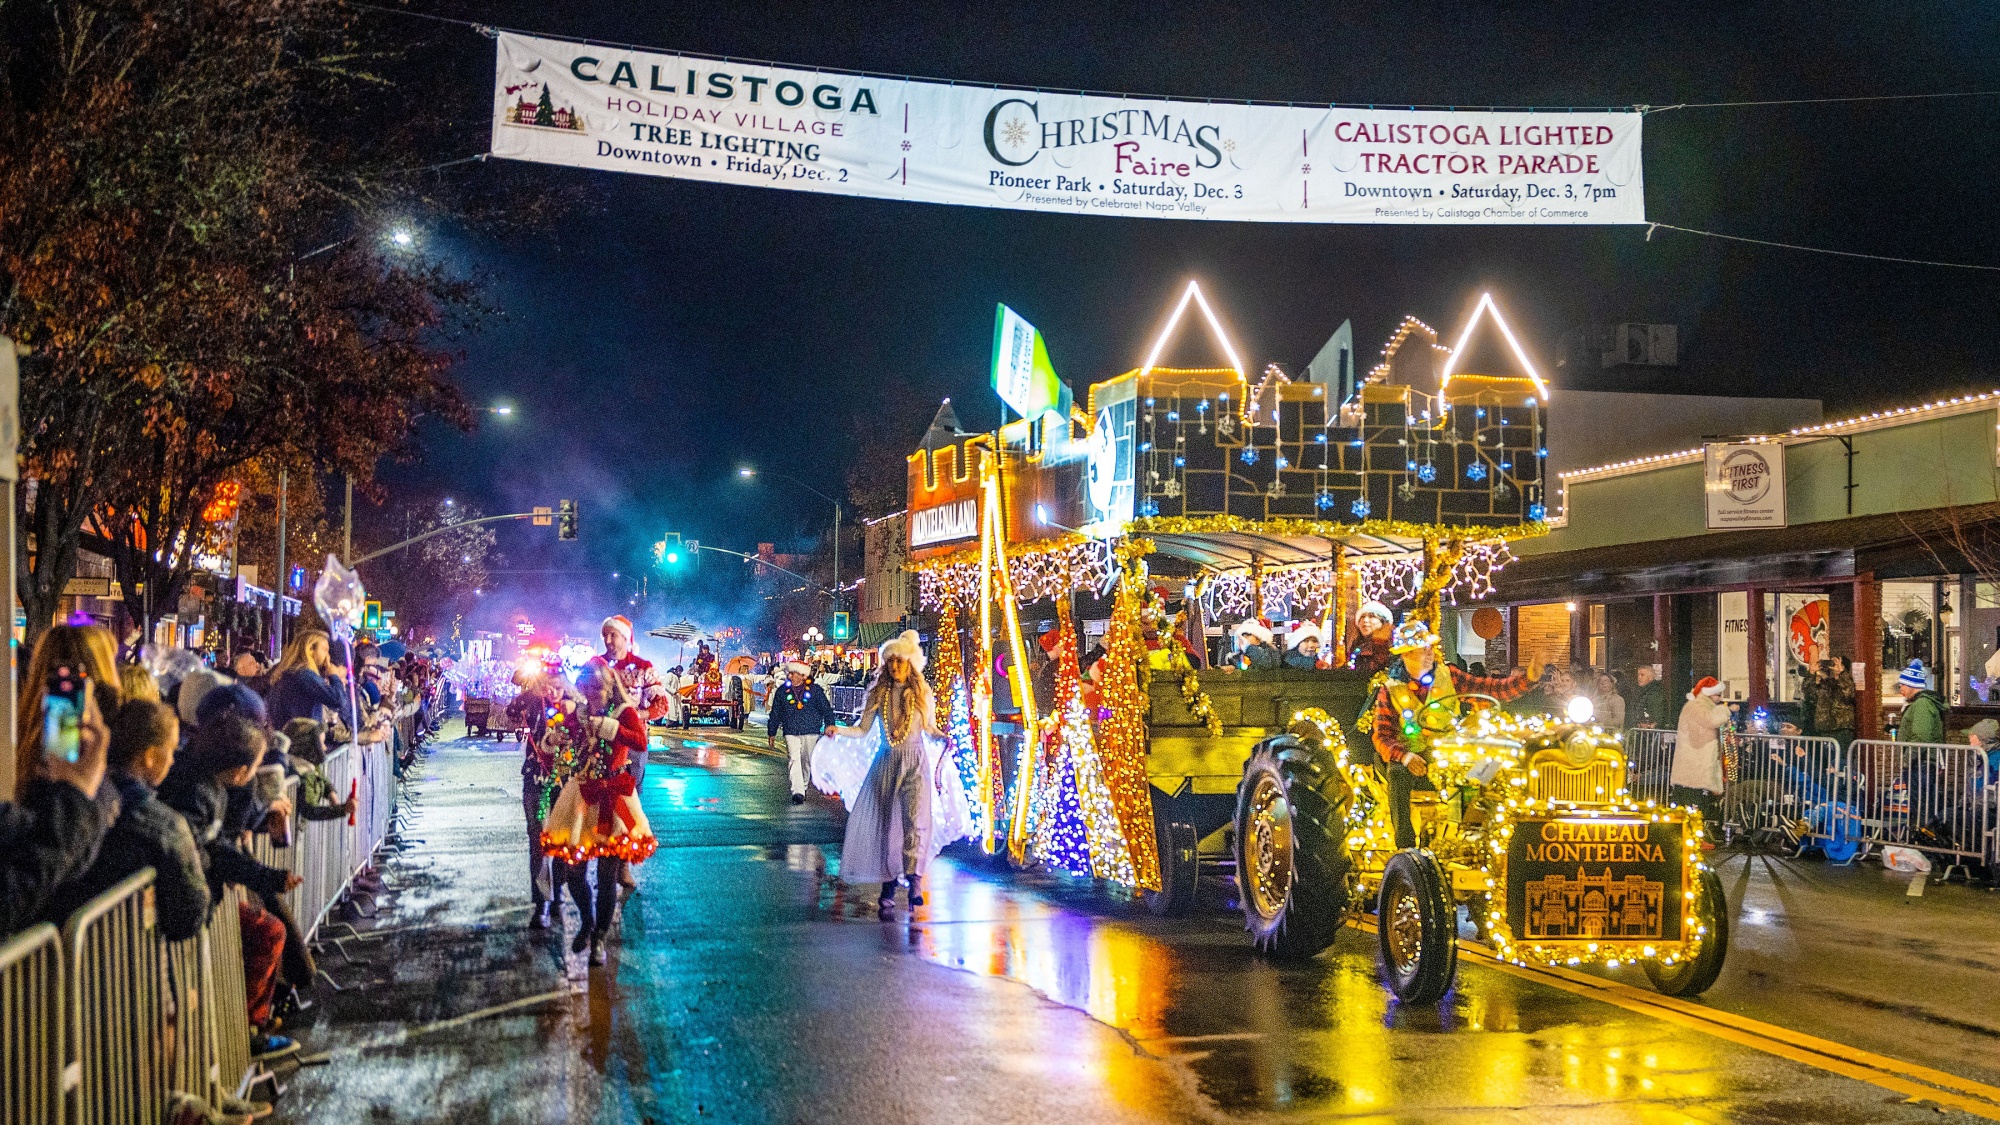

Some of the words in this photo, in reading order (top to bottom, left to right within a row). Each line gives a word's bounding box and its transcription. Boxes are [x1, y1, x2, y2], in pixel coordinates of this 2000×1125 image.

[570, 55, 879, 115] CALISTOGA
[606, 97, 722, 124] HOLIDAY
[734, 112, 845, 137] VILLAGE
[630, 122, 693, 146] TREE
[699, 134, 821, 163] LIGHTING
[983, 98, 1222, 168] CHRISTMAS
[1334, 121, 1490, 146] CALISTOGA
[1499, 125, 1614, 147] LIGHTED
[597, 140, 702, 168] Downtown
[725, 155, 787, 181] Friday,
[792, 163, 831, 181] Dec.
[838, 168, 849, 183] 2
[1113, 141, 1190, 177] Faire
[1359, 152, 1489, 175] TRACTOR
[1498, 153, 1600, 175] PARADE
[988, 170, 1051, 191] Pioneer
[1056, 175, 1092, 193] Park
[1112, 178, 1189, 202] Saturday,
[1193, 183, 1230, 199] Dec.
[1233, 184, 1243, 200] 3
[1344, 182, 1433, 200] Downtown
[1451, 183, 1523, 202] Saturday,
[1526, 184, 1561, 200] Dec.
[1564, 185, 1578, 201] 3,
[1583, 185, 1617, 203] 7pm
[1025, 192, 1073, 206] Presented
[1075, 196, 1088, 209] by
[1091, 197, 1143, 210] Celebrate!
[1146, 202, 1174, 214] Napa
[1176, 202, 1207, 215] Valley
[1375, 207, 1419, 219] Presented
[1422, 207, 1434, 220] by
[1437, 207, 1481, 220] Calistoga
[1483, 208, 1525, 219] Chamber
[1528, 207, 1538, 219] of
[1540, 208, 1589, 219] Commerce
[1723, 463, 1764, 478] FITNESS
[1731, 476, 1760, 491] FIRST
[912, 499, 977, 541] MONTELENALAND
[1725, 619, 1749, 633] FITNES
[1541, 823, 1649, 843] CHATEAU
[1526, 843, 1666, 862] MONTELENA
